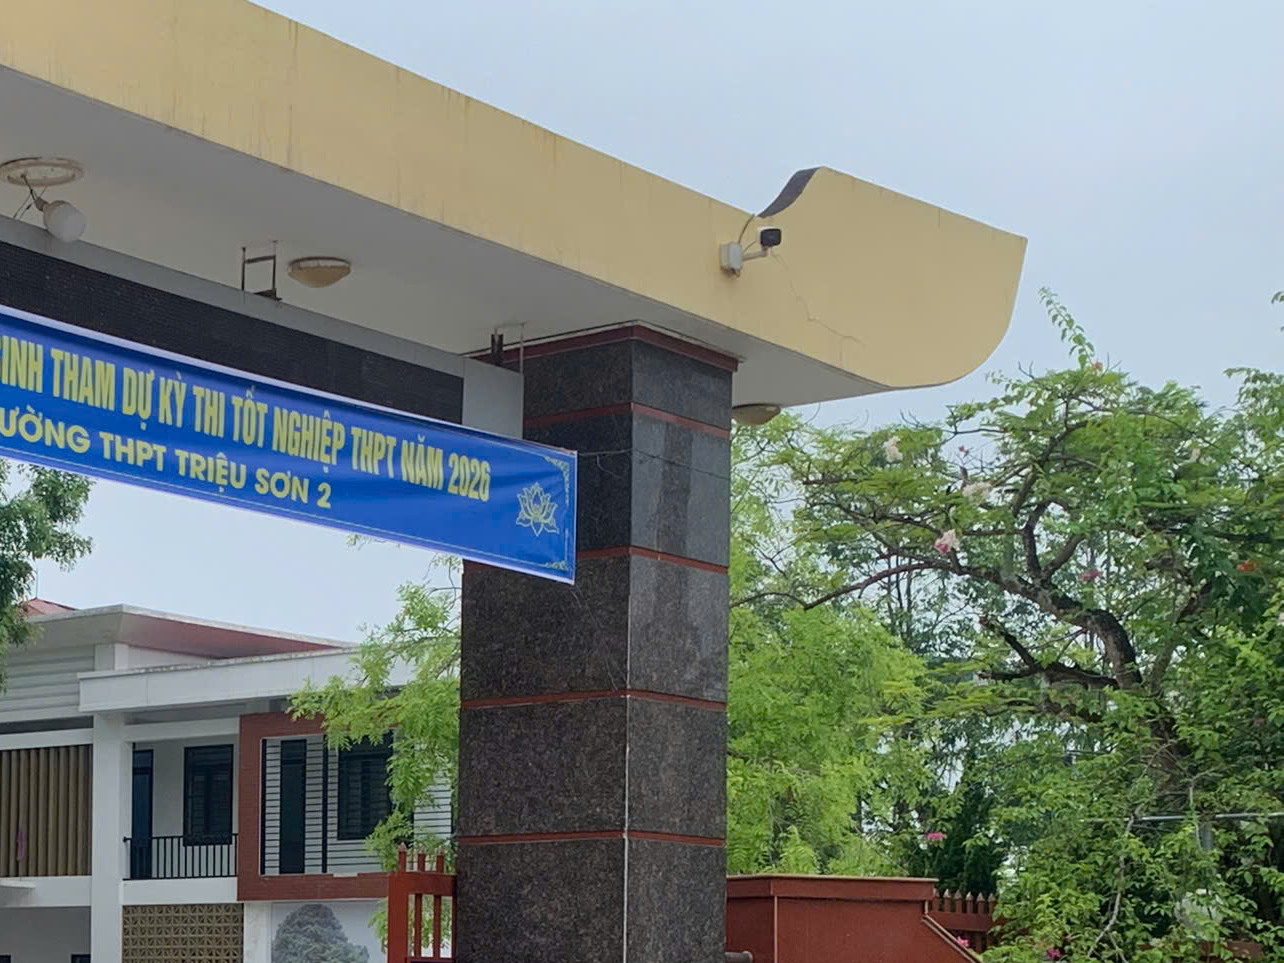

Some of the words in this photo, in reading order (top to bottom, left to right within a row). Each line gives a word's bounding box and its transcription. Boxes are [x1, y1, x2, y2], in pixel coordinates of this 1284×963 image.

[51, 348, 116, 411] THAM
[122, 368, 155, 430] DỰ
[159, 371, 187, 428] KỲ
[193, 385, 226, 437] THI
[232, 385, 269, 447] TỐT
[273, 407, 346, 473] NGHIỆP
[351, 426, 397, 478] THPT
[401, 434, 444, 491] NĂM
[448, 453, 491, 502] 2026
[100, 431, 166, 473] THPT
[175, 450, 247, 494] TRIỆU
[254, 467, 309, 504] SƠN
[317, 482, 332, 510] 2
